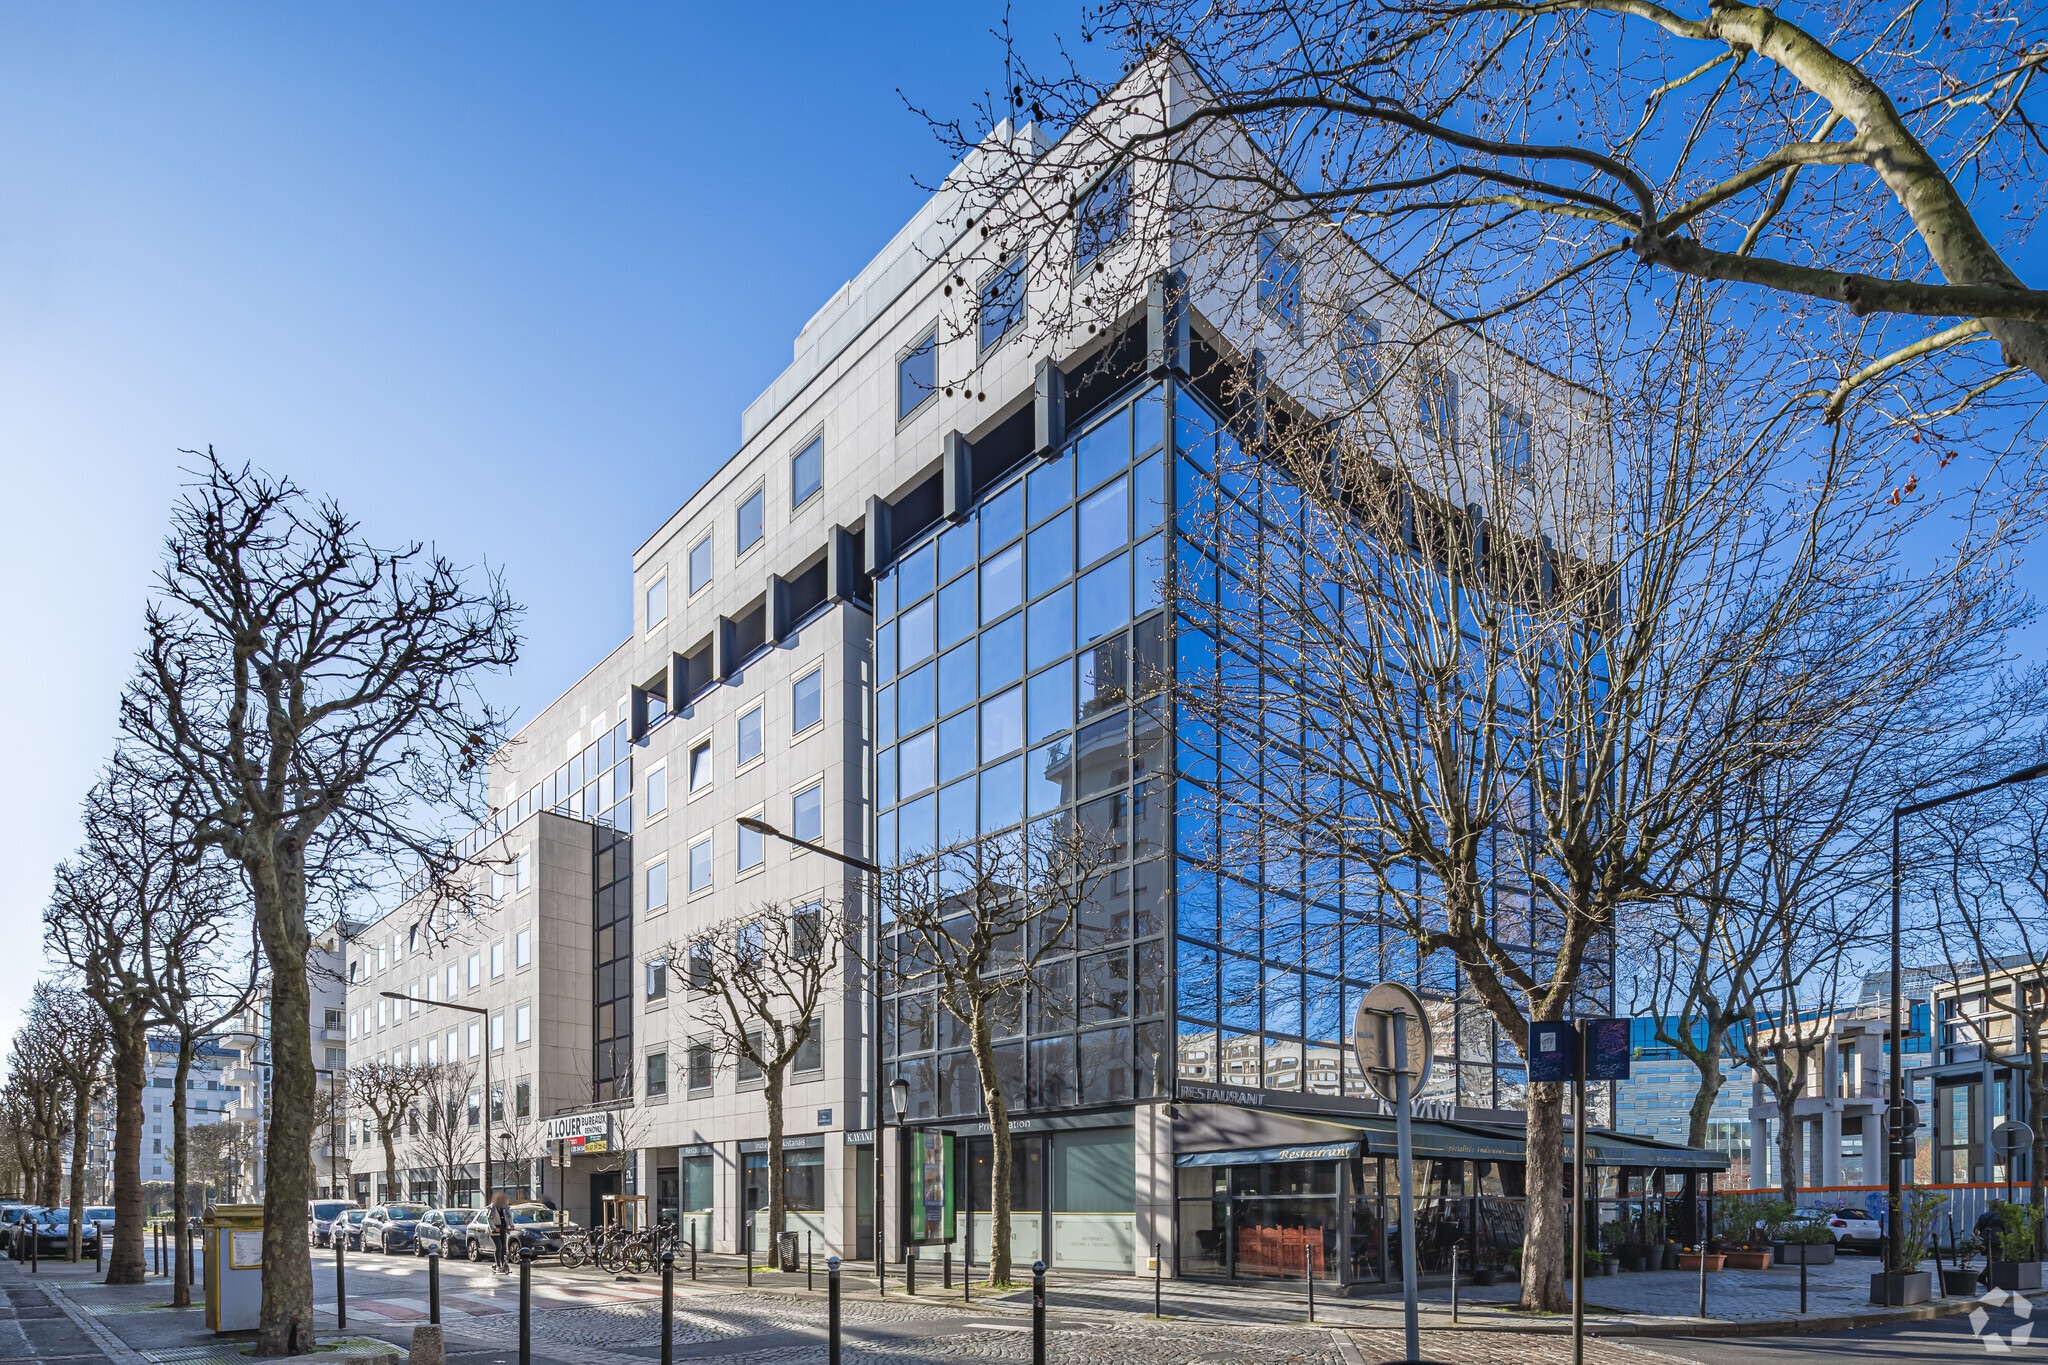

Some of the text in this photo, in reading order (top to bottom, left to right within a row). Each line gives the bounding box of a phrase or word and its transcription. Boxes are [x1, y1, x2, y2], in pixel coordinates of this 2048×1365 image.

[1181, 1085, 1266, 1105] RESTAURANT
[1378, 1099, 1456, 1120] KYANI
[547, 1117, 581, 1138] A LOUER
[979, 1120, 1031, 1131] Priation
[847, 1131, 873, 1142] KAYANI
[1280, 1147, 1350, 1159] Restaurant
